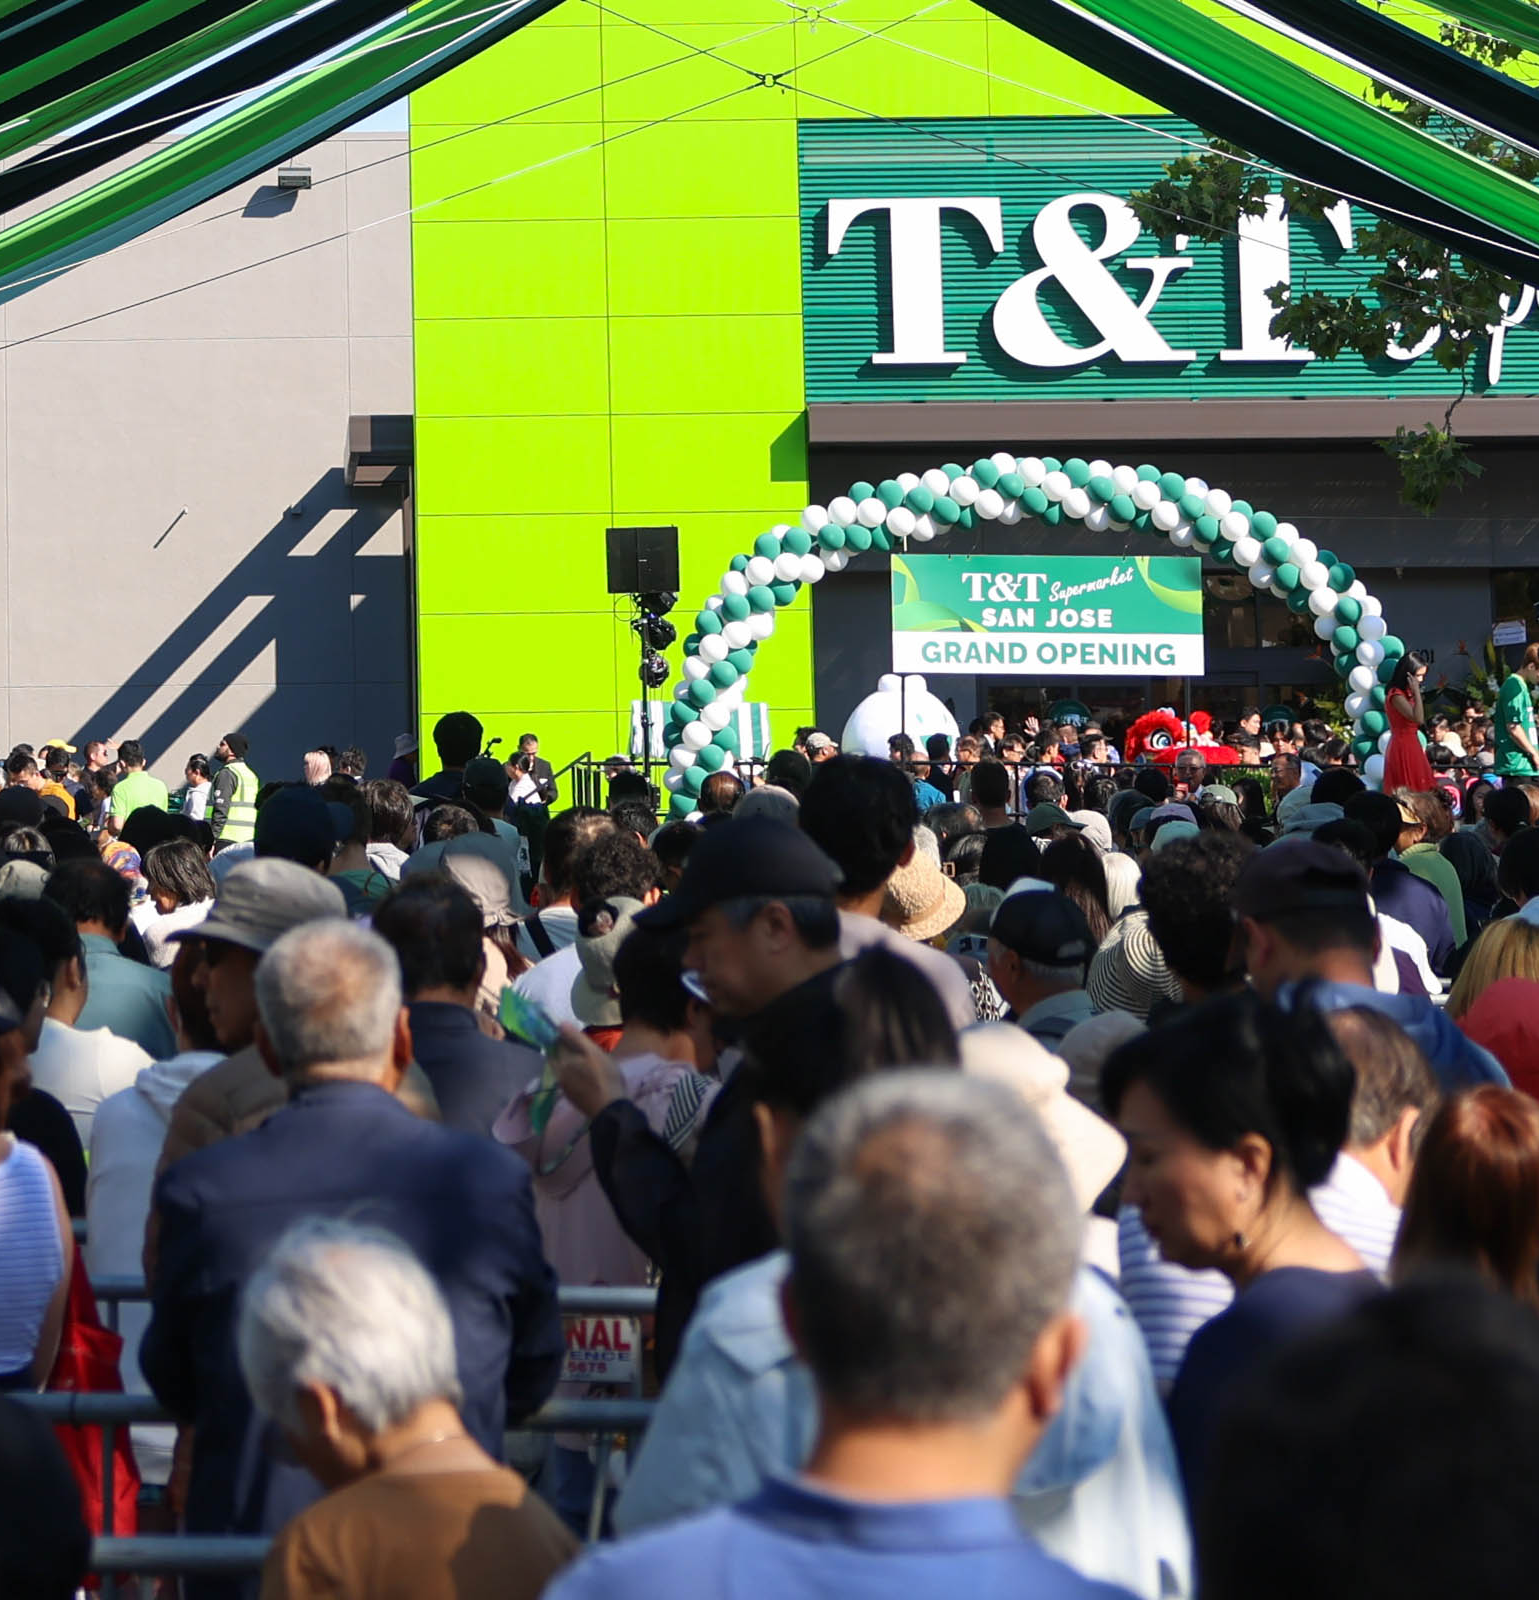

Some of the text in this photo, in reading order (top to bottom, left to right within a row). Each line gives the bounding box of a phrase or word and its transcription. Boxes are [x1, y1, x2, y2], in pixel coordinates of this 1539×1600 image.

[962, 566, 1134, 606] T&T Supermarket
[981, 608, 1112, 628] SAN JOSE
[921, 641, 1176, 666] GRAND OPENING
